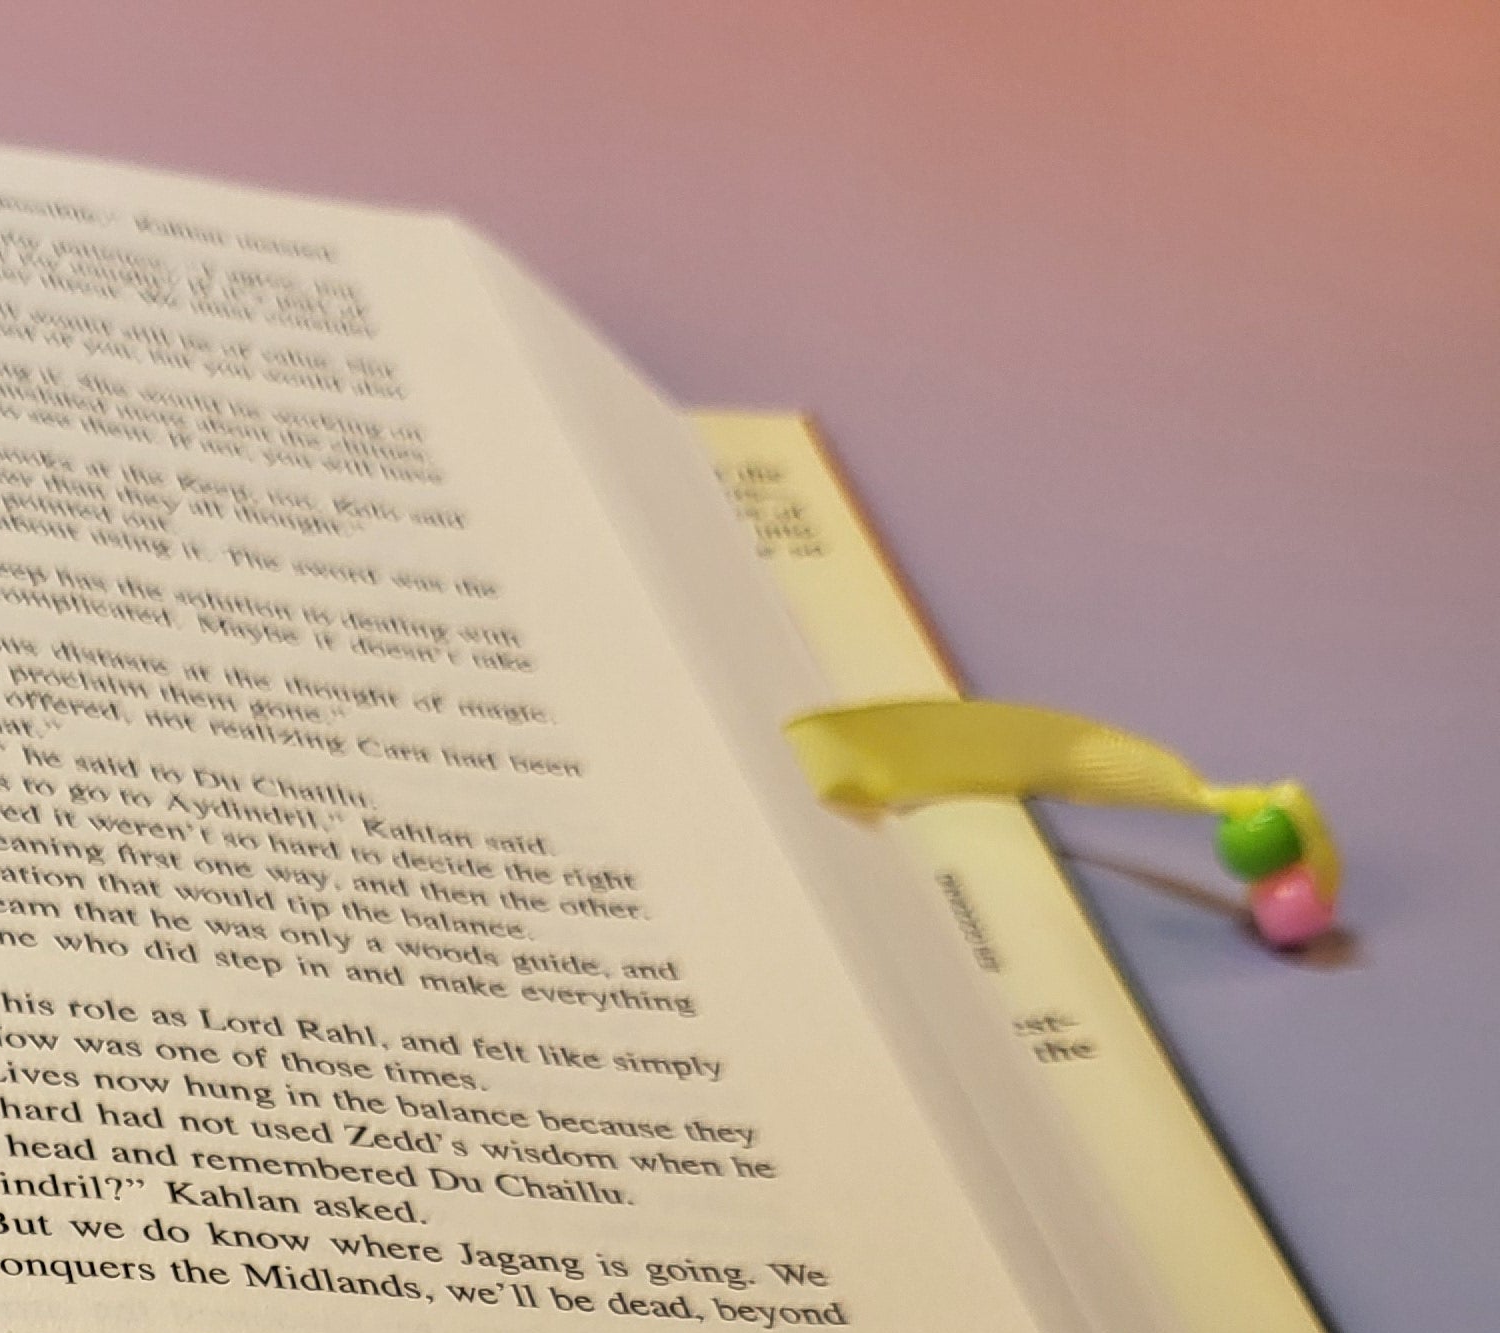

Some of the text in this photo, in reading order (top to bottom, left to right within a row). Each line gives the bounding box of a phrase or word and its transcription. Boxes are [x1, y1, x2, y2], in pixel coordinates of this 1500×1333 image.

[0, 990, 55, 1016] his
[67, 998, 139, 1023] role
[151, 1009, 188, 1027] as
[198, 1007, 285, 1037] Lord
[295, 1018, 389, 1051] Rahl,
[400, 1033, 462, 1059] and
[472, 1036, 531, 1064] felt
[537, 1044, 603, 1070] like
[612, 1051, 721, 1083] simply
[169, 1258, 231, 1285] the
[241, 1263, 434, 1305] Midlands,
[445, 1282, 540, 1309] we’ll
[547, 1286, 596, 1313] be
[607, 1291, 705, 1323] dead,
[711, 1297, 849, 1330] beyond
